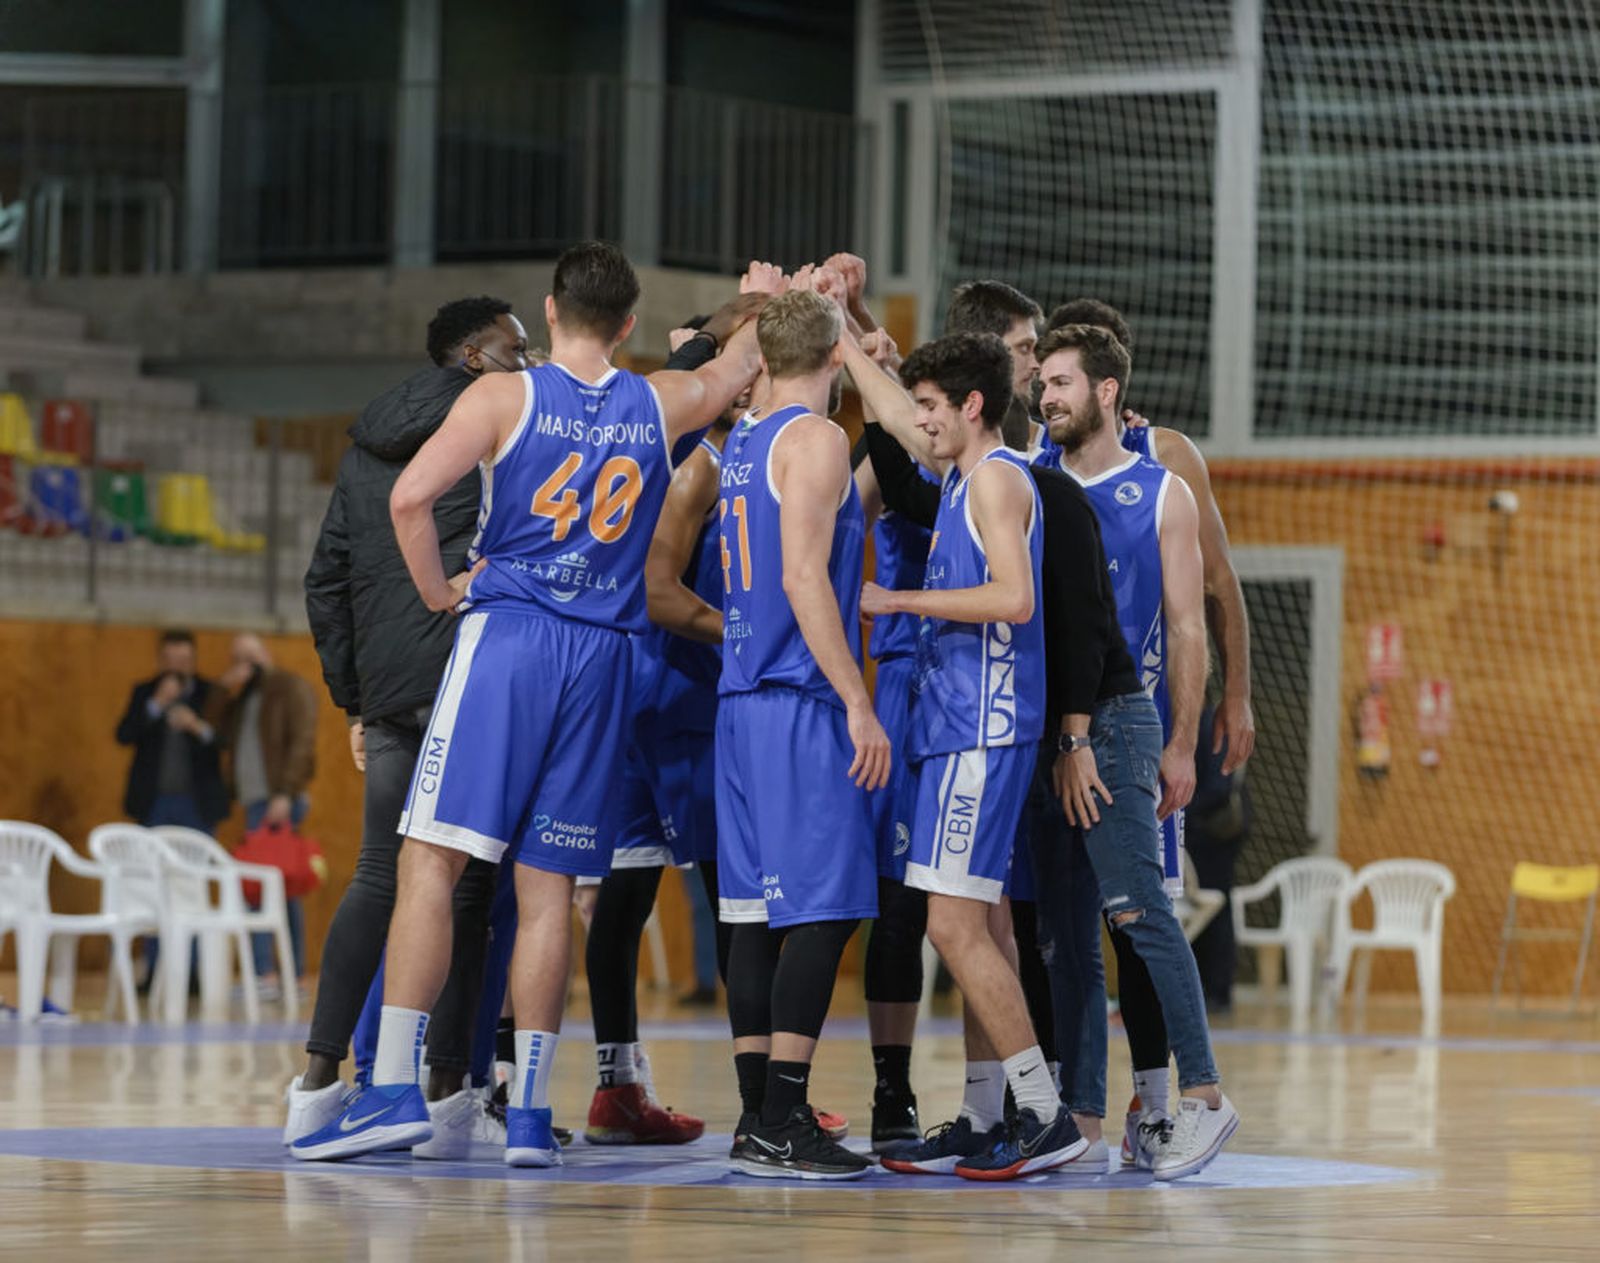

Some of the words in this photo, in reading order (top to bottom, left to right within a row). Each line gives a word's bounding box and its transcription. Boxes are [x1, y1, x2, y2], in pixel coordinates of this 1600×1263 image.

[531, 452, 643, 543] 40
[511, 560, 617, 592] MARBELLA
[421, 736, 446, 794] CBM
[541, 832, 596, 850] OCHOA
[552, 820, 597, 836] Hospital
[946, 794, 977, 855] CBM
